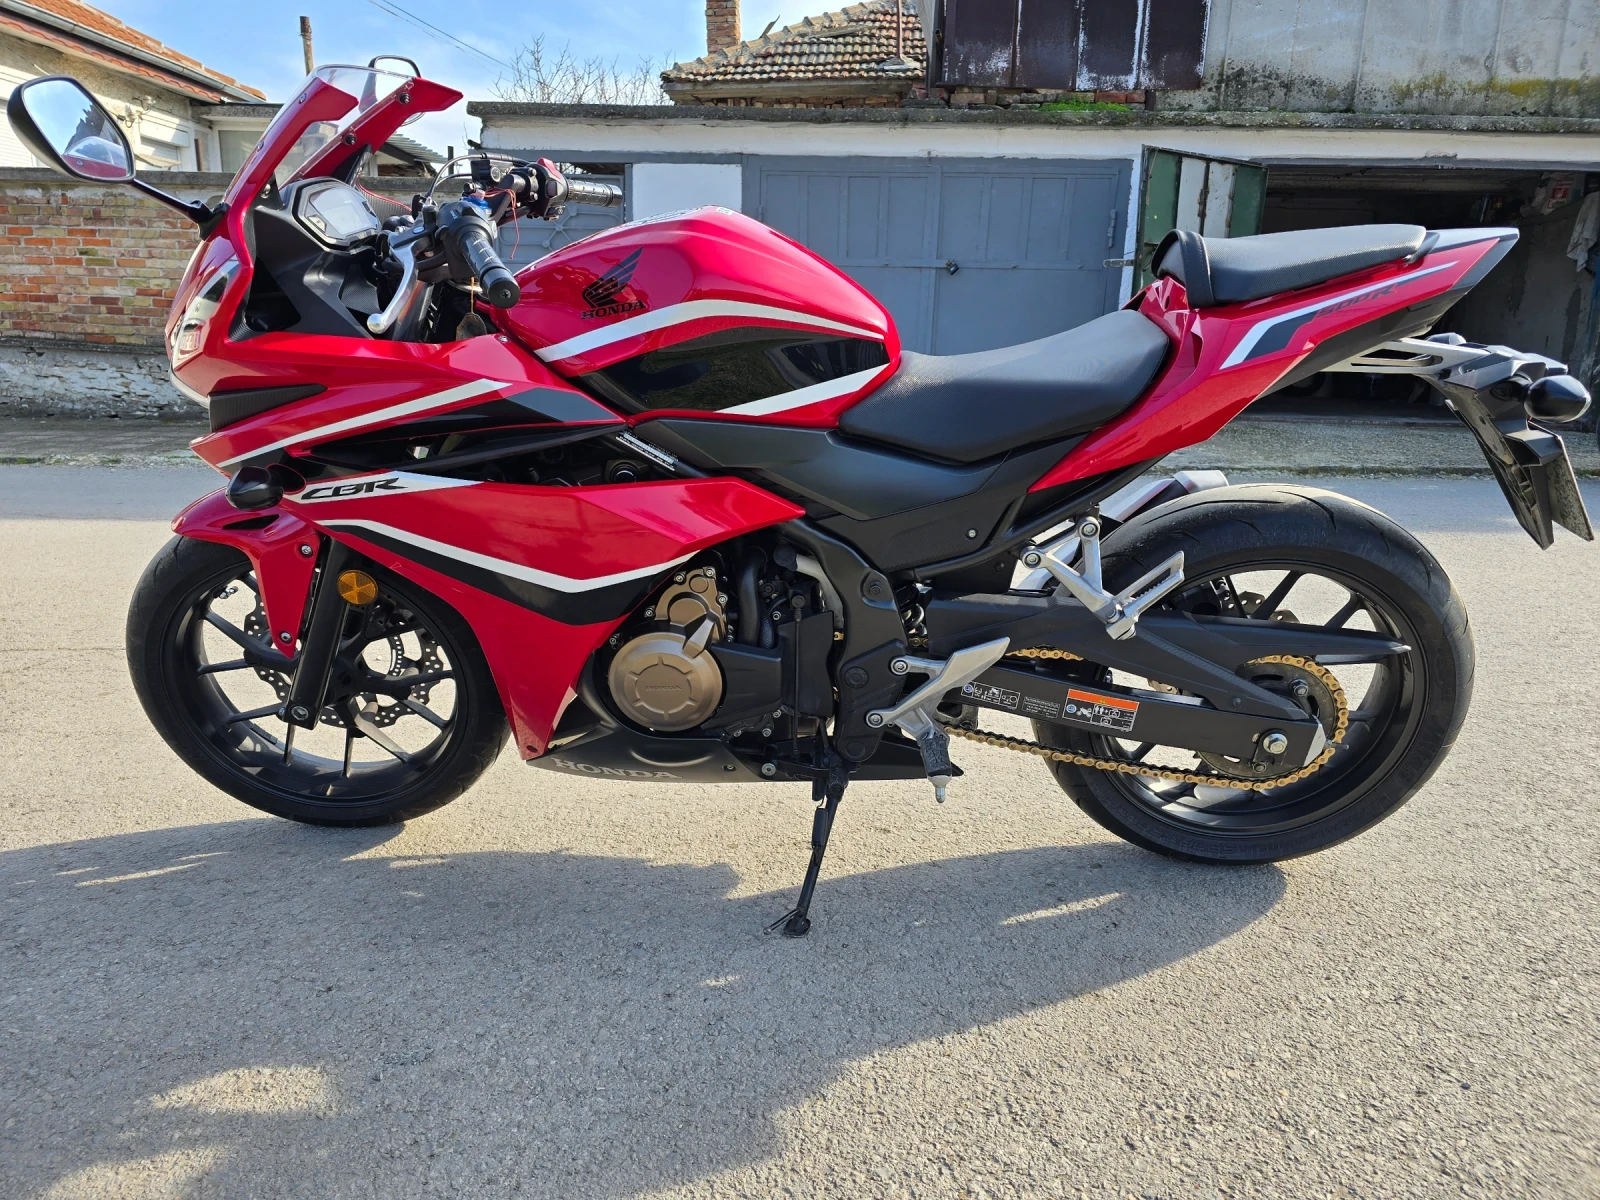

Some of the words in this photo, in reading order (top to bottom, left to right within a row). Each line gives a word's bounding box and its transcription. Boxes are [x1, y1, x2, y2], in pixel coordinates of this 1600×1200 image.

[581, 300, 647, 319] HONDA
[301, 477, 409, 500] CBR
[551, 757, 683, 779] HONDA
